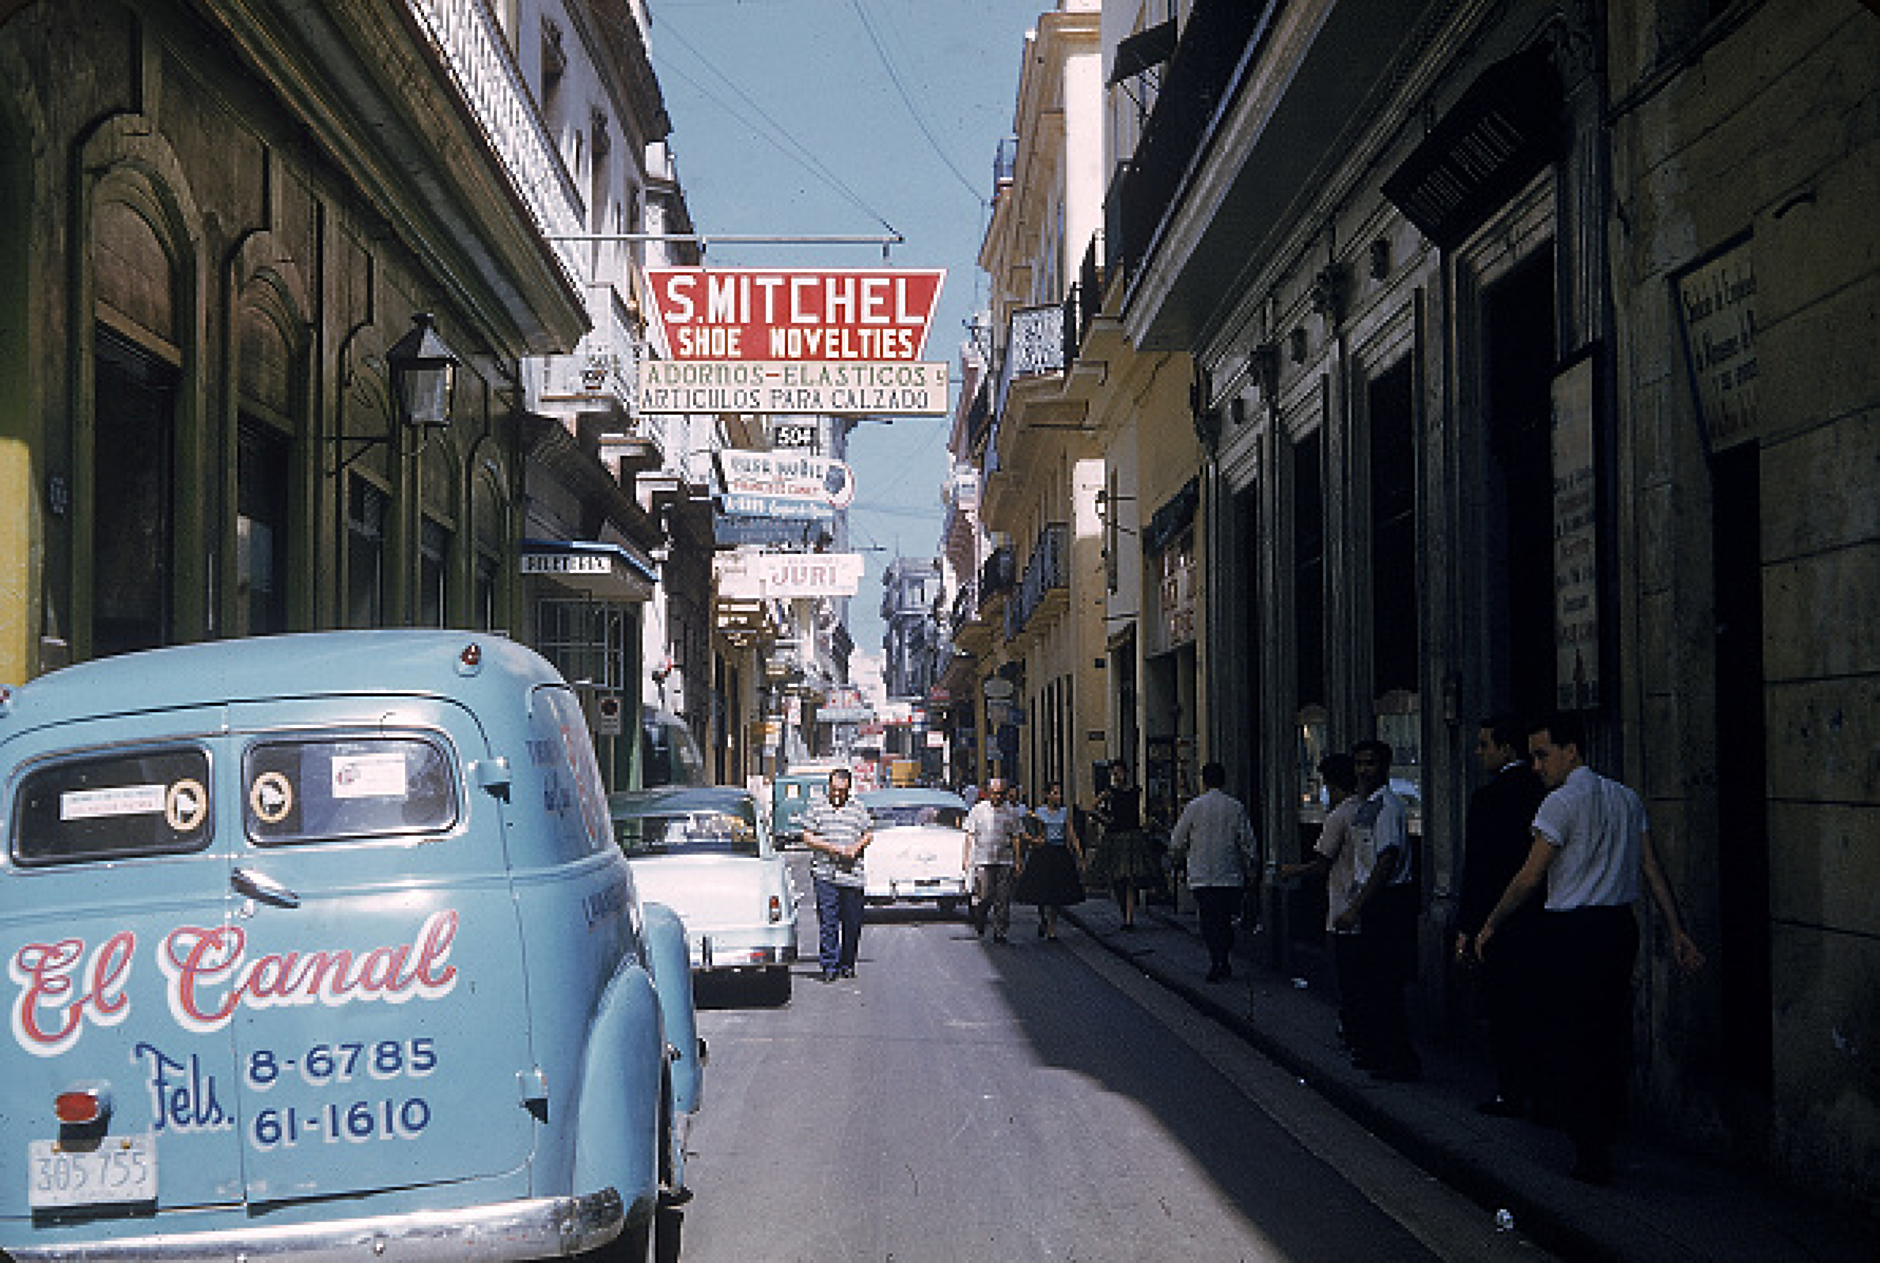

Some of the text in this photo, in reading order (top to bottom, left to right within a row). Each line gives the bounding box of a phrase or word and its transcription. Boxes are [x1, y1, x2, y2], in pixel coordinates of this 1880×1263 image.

[664, 275, 925, 324] S.MITCHEL
[677, 327, 913, 358] SHOE NOVELTIES
[642, 388, 928, 409] ARTICULOS PARA CALZADO
[9, 909, 460, 1056] El Canal
[245, 1038, 438, 1089] 8-6785
[251, 1098, 431, 1151] 61-1610
